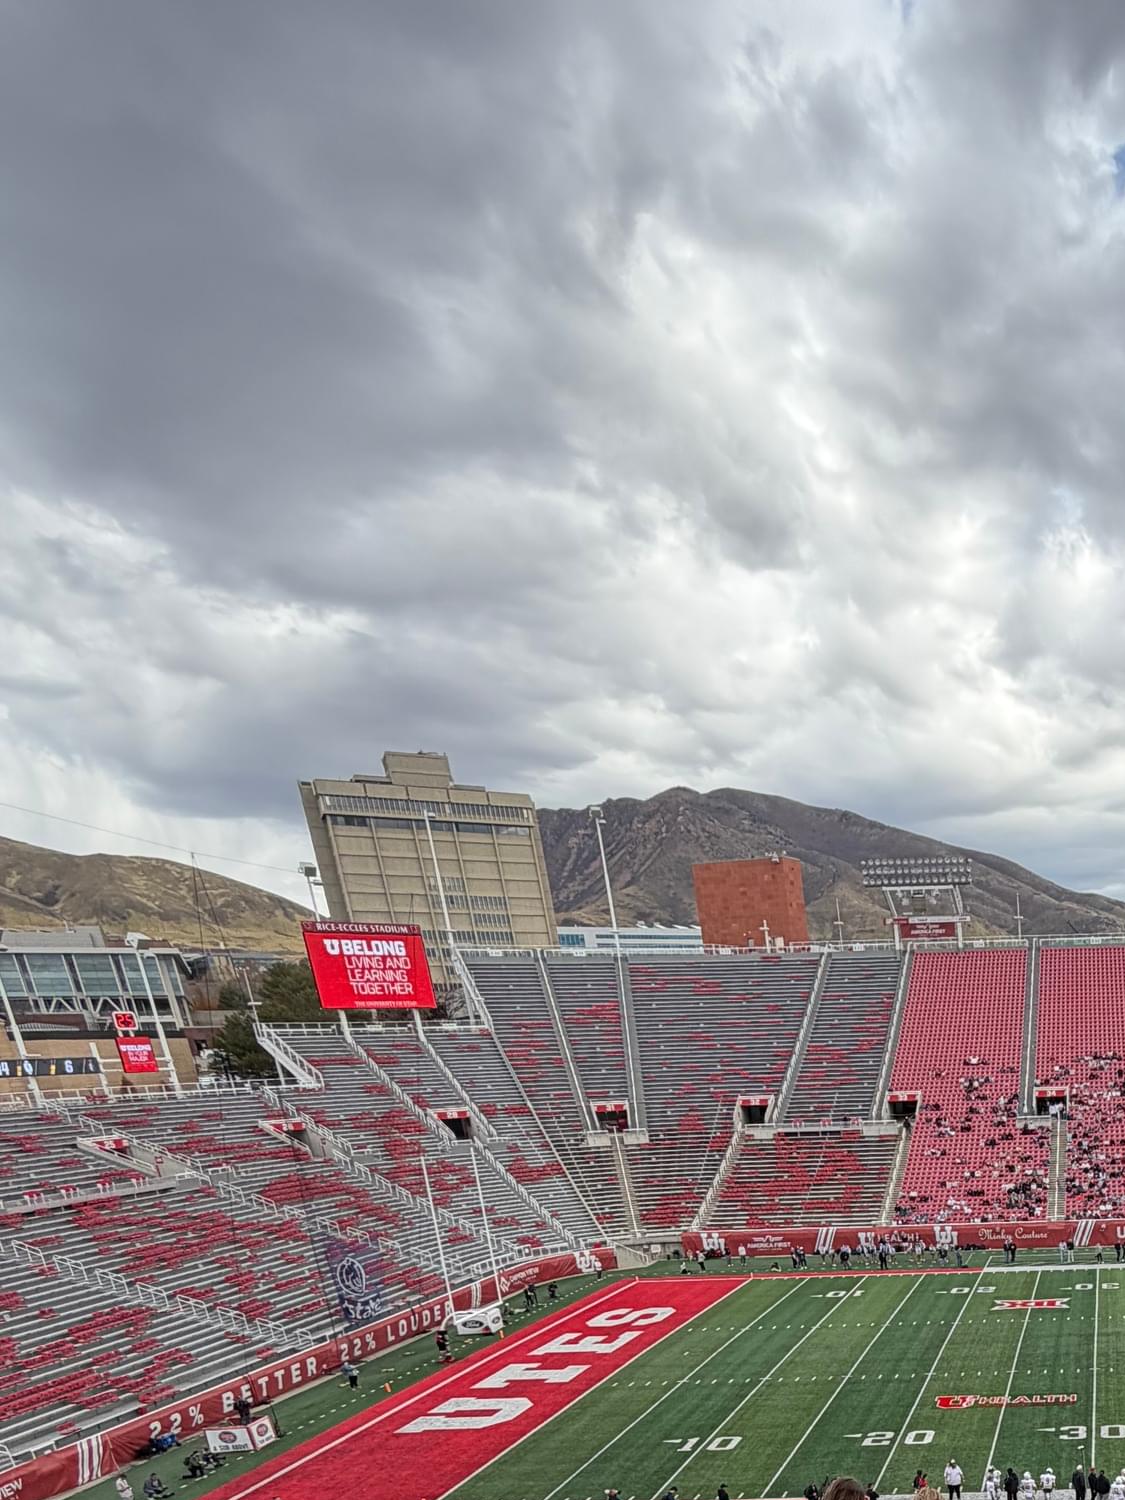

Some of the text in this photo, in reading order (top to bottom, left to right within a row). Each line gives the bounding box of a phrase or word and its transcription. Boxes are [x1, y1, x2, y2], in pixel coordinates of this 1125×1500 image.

[316, 923, 409, 934] RICE-ECCLES STADIUM
[341, 940, 407, 956] BELONG
[344, 956, 412, 969] LIVING AND
[347, 969, 408, 982] LEARNING
[350, 982, 414, 995] TOGETHER
[117, 1014, 134, 1027] 25
[340, 1300, 452, 1361] 22% LOUDER
[392, 1306, 678, 1434] UTES
[976, 1393, 1078, 1406] HEALTH
[150, 1403, 204, 1440] 22%
[677, 1435, 743, 1453] 10
[860, 1430, 936, 1446] 20
